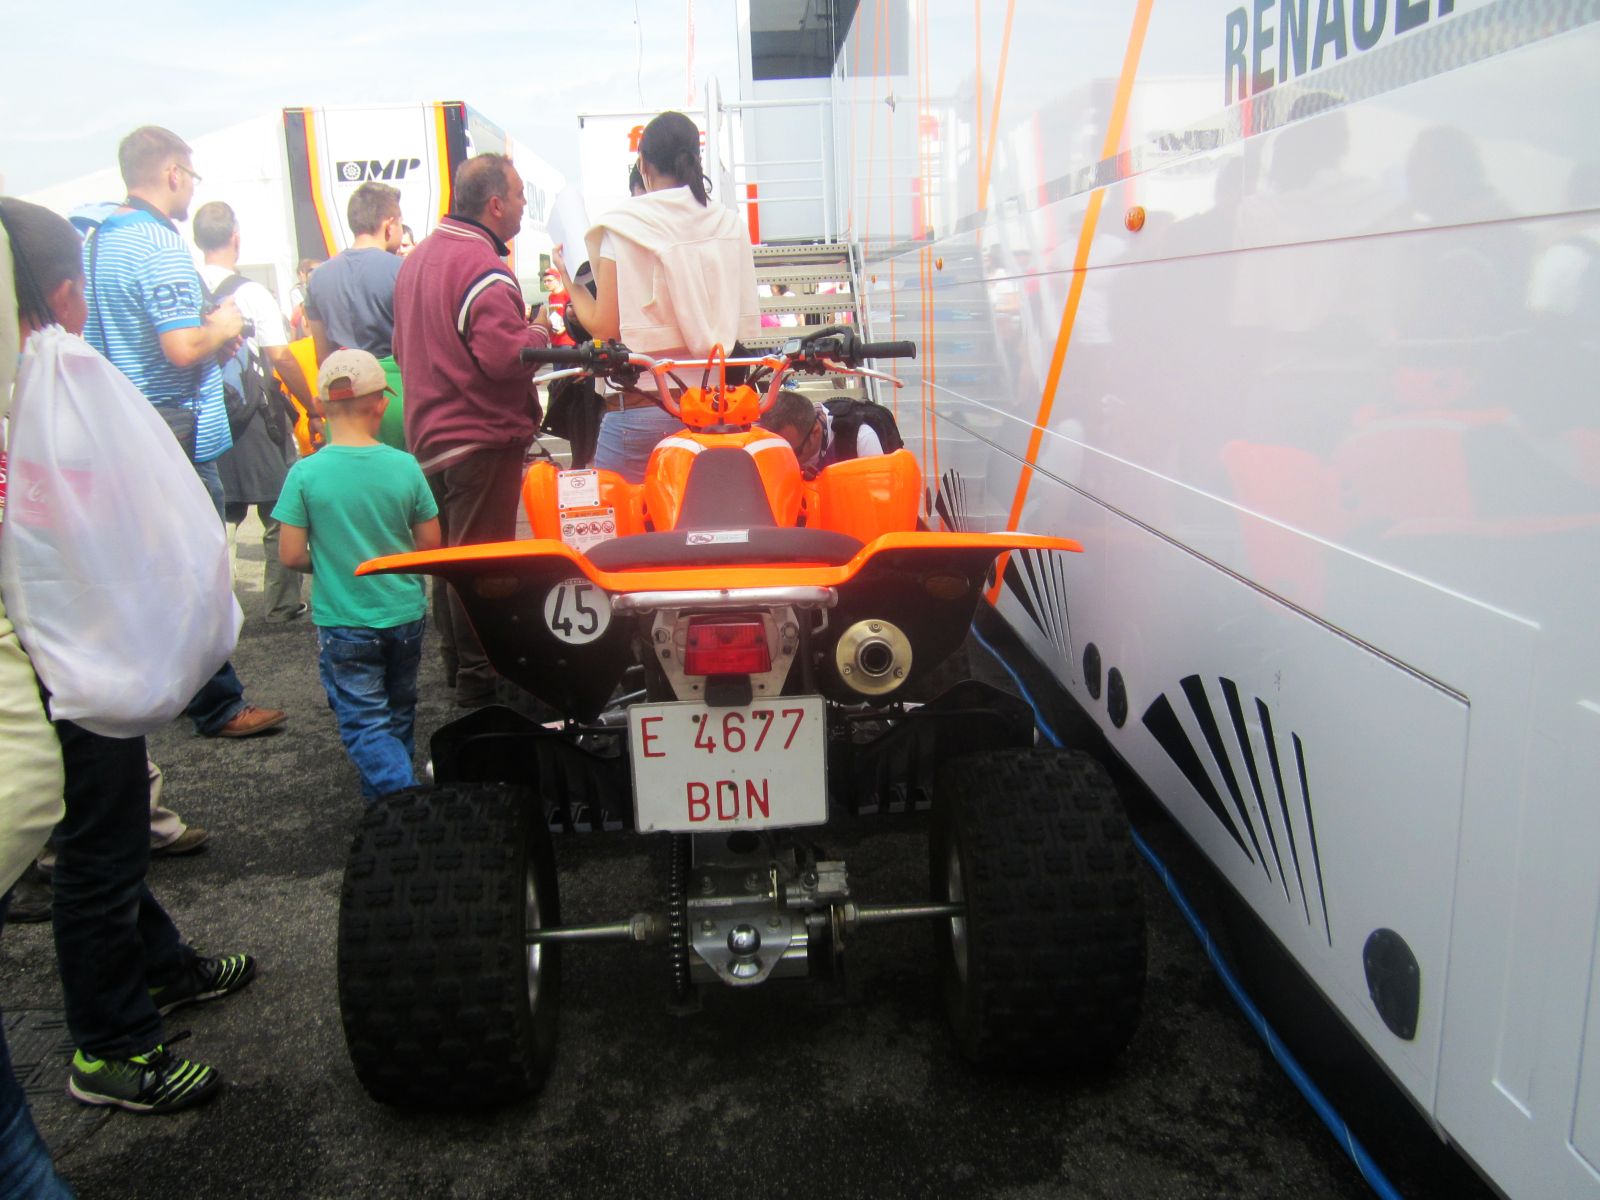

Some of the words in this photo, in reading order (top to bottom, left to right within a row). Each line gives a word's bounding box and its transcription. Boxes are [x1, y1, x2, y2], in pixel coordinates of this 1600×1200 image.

[1224, 0, 1454, 107] RENAU
[552, 584, 598, 637] 45
[641, 716, 666, 758] E
[694, 708, 804, 754] 4677
[687, 778, 770, 822] BDN
